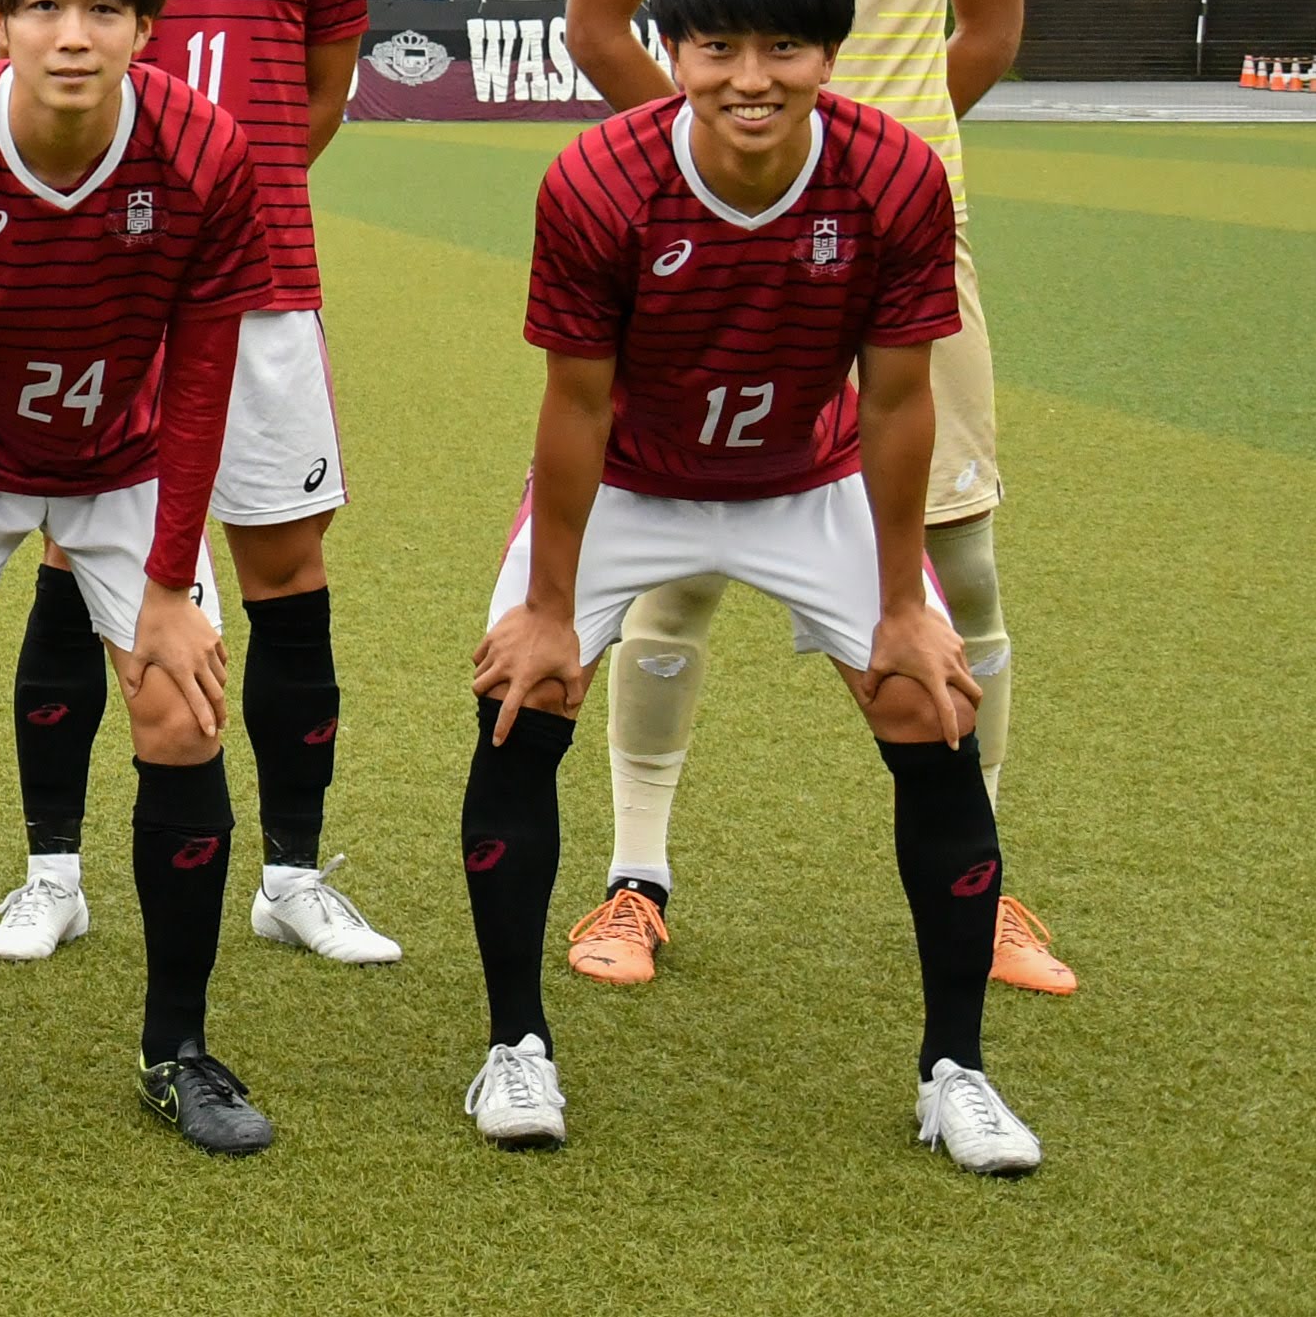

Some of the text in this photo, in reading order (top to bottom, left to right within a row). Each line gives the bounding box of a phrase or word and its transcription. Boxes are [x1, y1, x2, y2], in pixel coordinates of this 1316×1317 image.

[187, 31, 226, 106] 11
[17, 359, 106, 427] 24
[698, 381, 775, 448] 12
